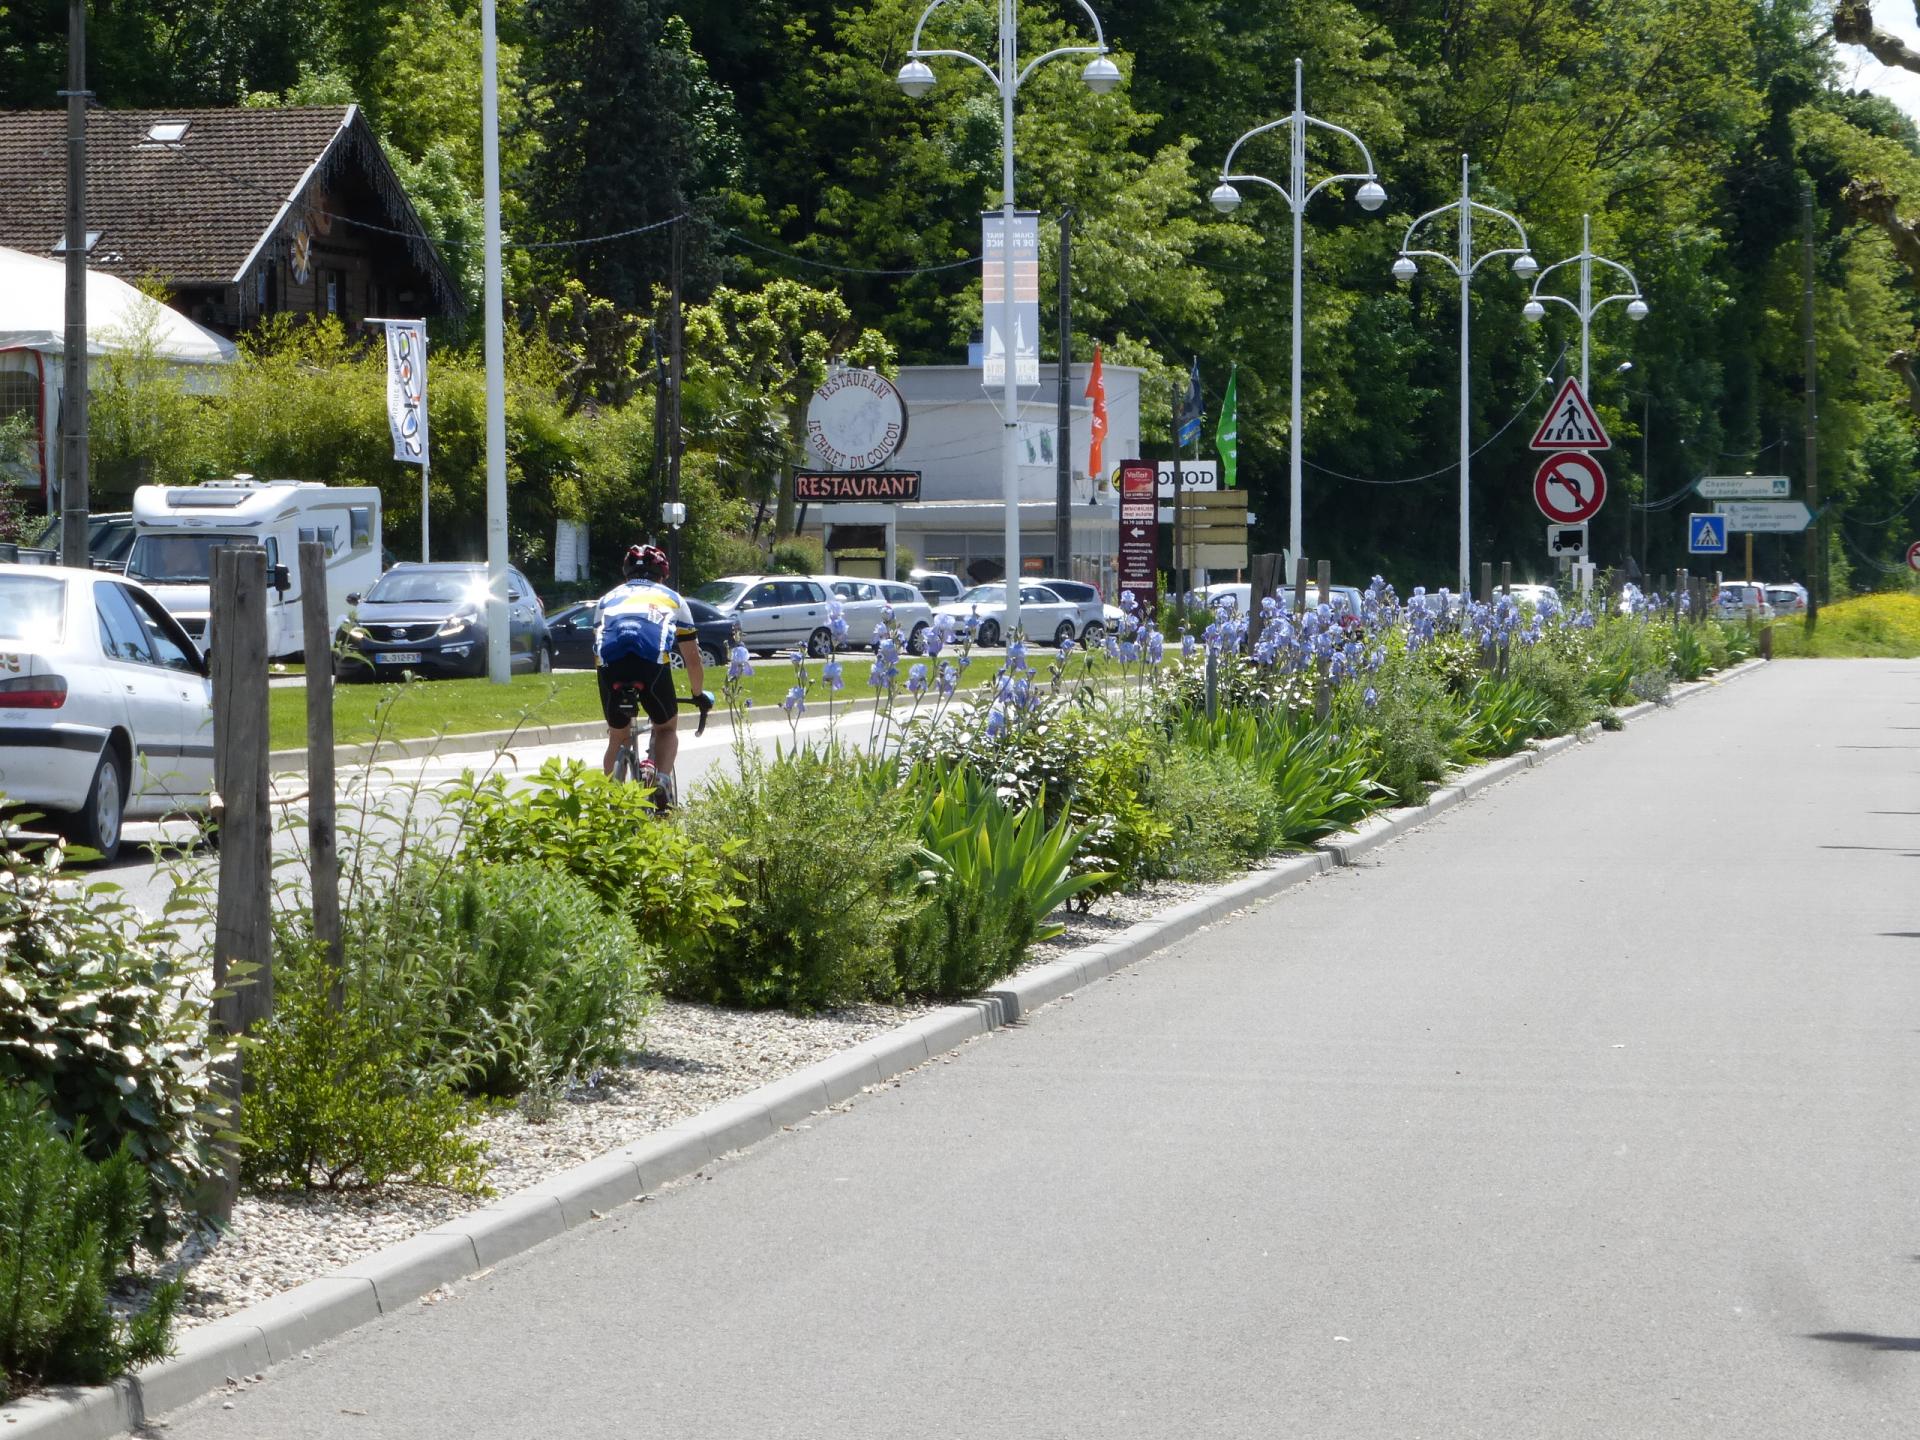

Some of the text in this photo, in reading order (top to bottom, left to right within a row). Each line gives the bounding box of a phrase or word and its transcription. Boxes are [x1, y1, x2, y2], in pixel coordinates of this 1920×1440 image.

[817, 371, 891, 401] RESTAURANT
[808, 420, 901, 470] LE CHALET DU COUCOU
[797, 476, 918, 496] RESTAURANT
